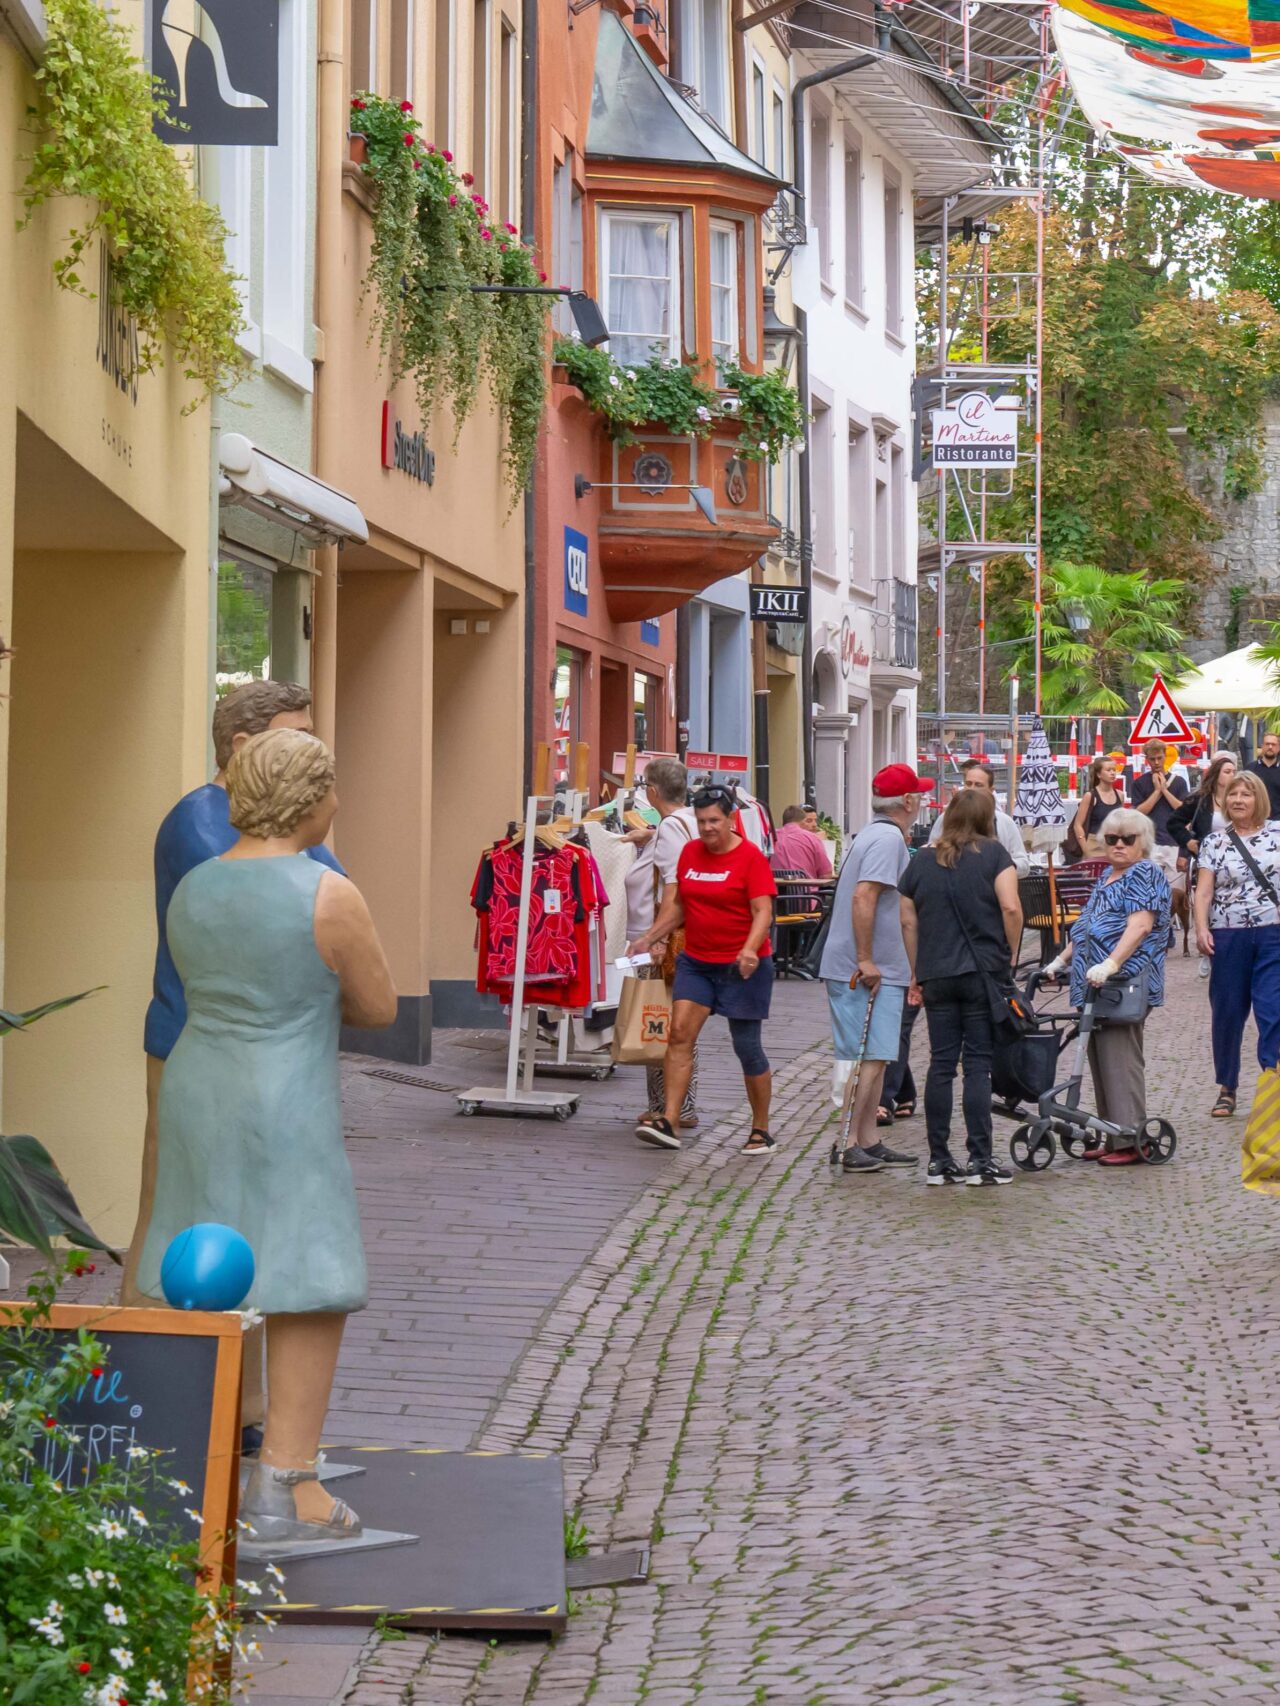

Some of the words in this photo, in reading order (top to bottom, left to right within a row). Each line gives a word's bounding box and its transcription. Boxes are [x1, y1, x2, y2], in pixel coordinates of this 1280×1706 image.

[965, 400, 985, 419] il
[102, 417, 133, 468] SCHUHE
[937, 423, 1015, 447] Martino
[937, 446, 1013, 460] Ristorante
[690, 756, 715, 767] SALE
[648, 1020, 664, 1034] M
